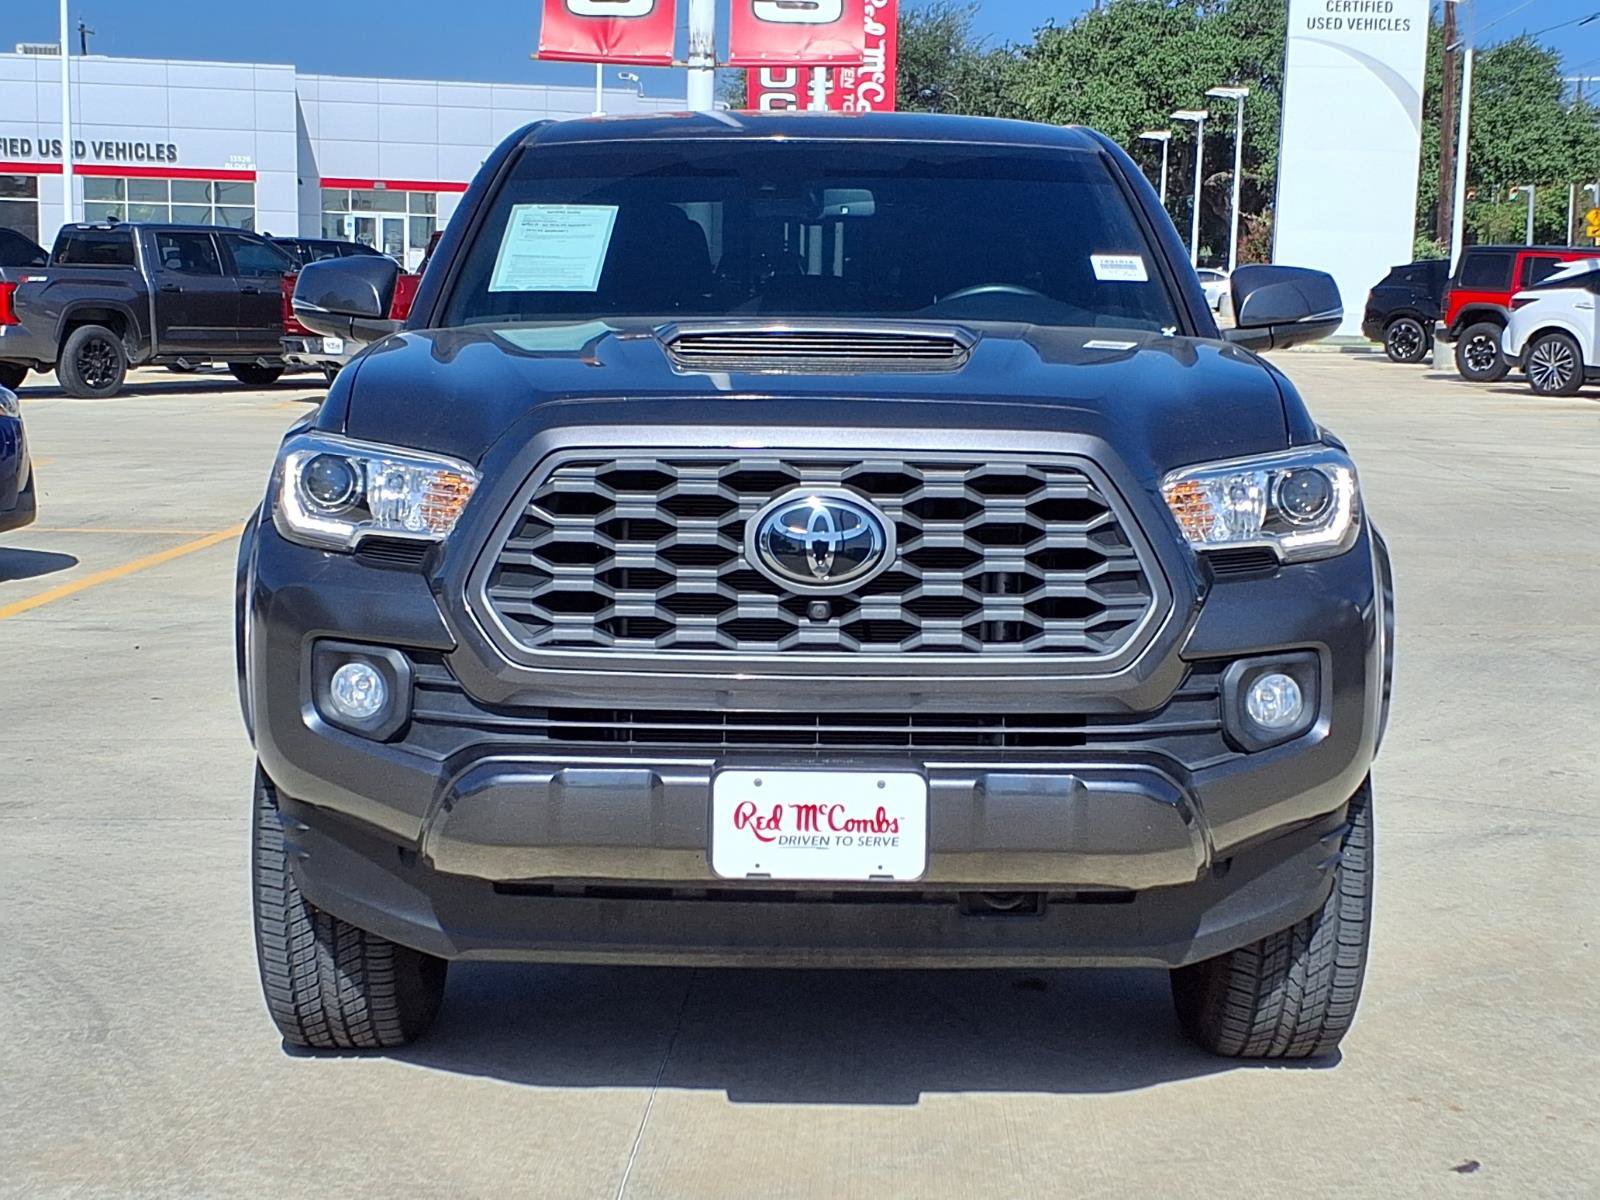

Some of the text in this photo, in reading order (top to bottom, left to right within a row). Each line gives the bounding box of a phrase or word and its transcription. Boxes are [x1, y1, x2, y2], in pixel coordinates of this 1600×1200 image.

[1326, 0, 1393, 13] CERTIFIED
[1307, 17, 1410, 32] USED VEHICLES
[0, 137, 177, 162] IED USD VEHICLES
[734, 801, 899, 842] Red McCombs
[778, 835, 900, 847] DRIVEN TO SERVE
